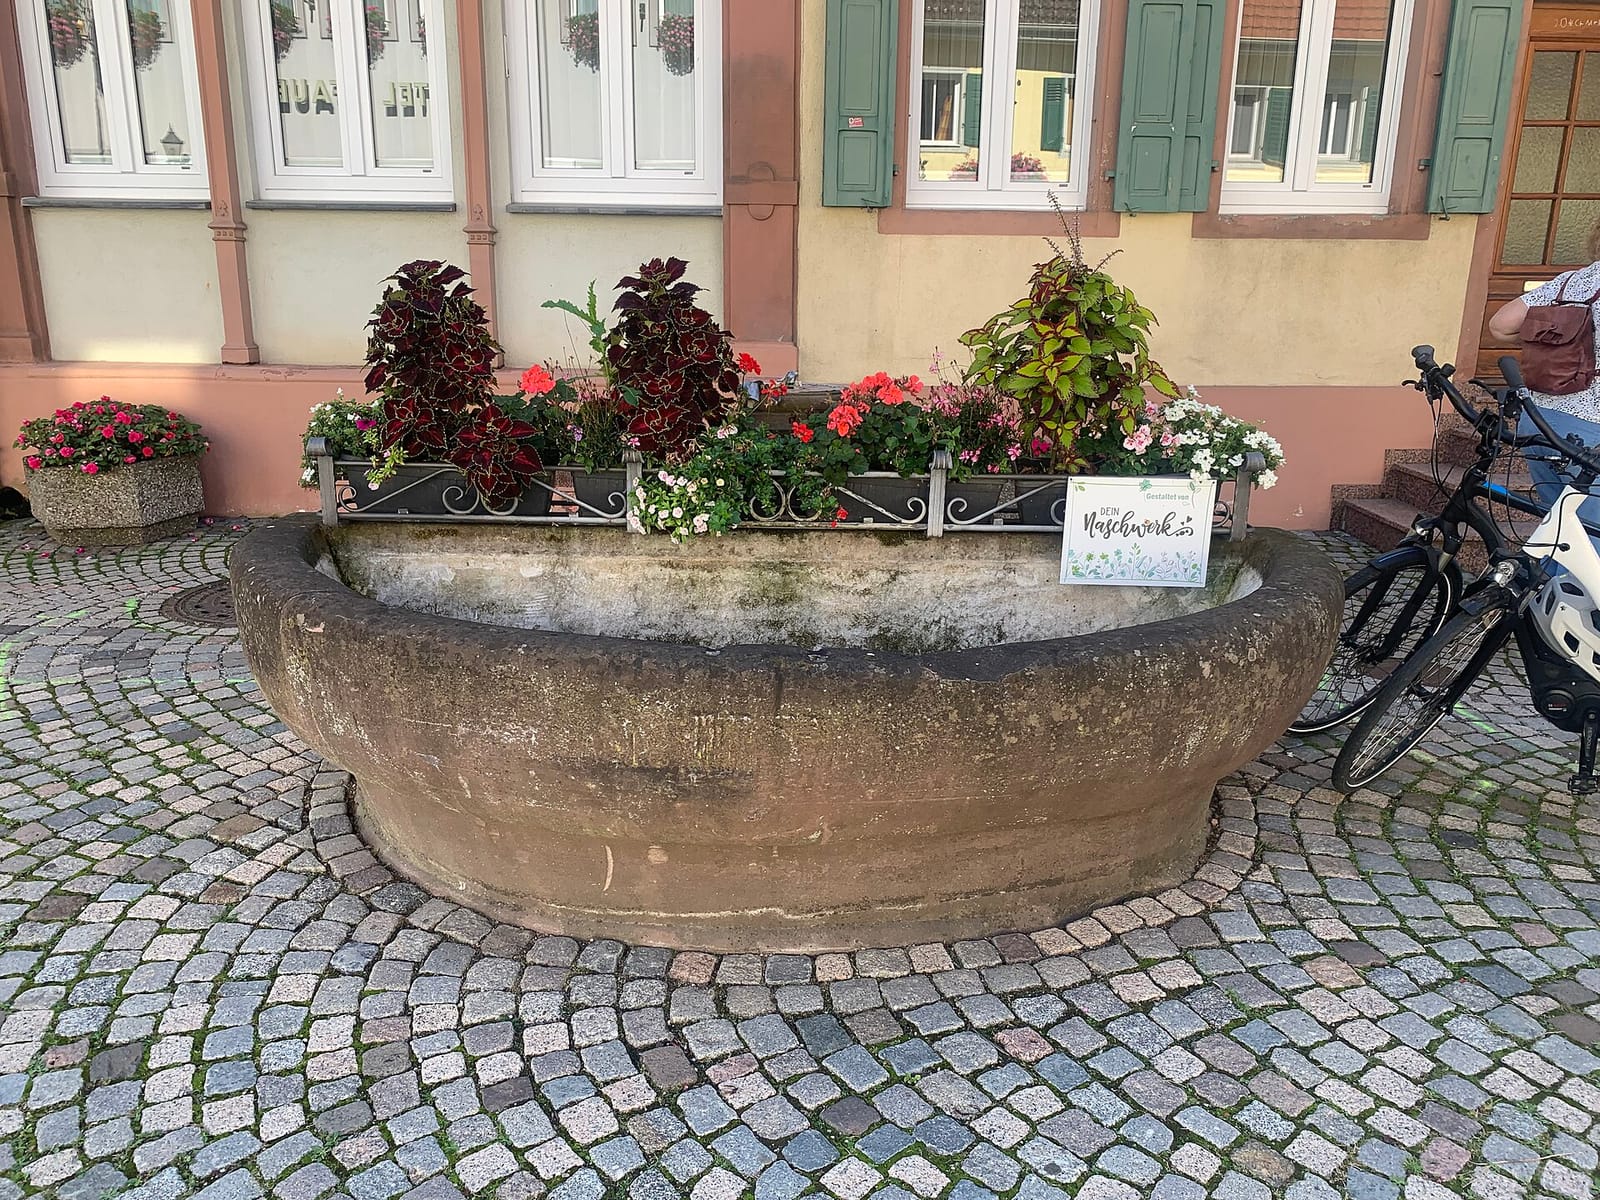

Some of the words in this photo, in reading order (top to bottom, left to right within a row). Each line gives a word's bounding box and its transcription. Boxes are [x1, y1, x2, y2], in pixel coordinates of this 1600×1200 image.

[1146, 493, 1177, 501] Gestaltet
[1100, 506, 1120, 516] DEIN
[1084, 510, 1184, 539] Naschwerk
